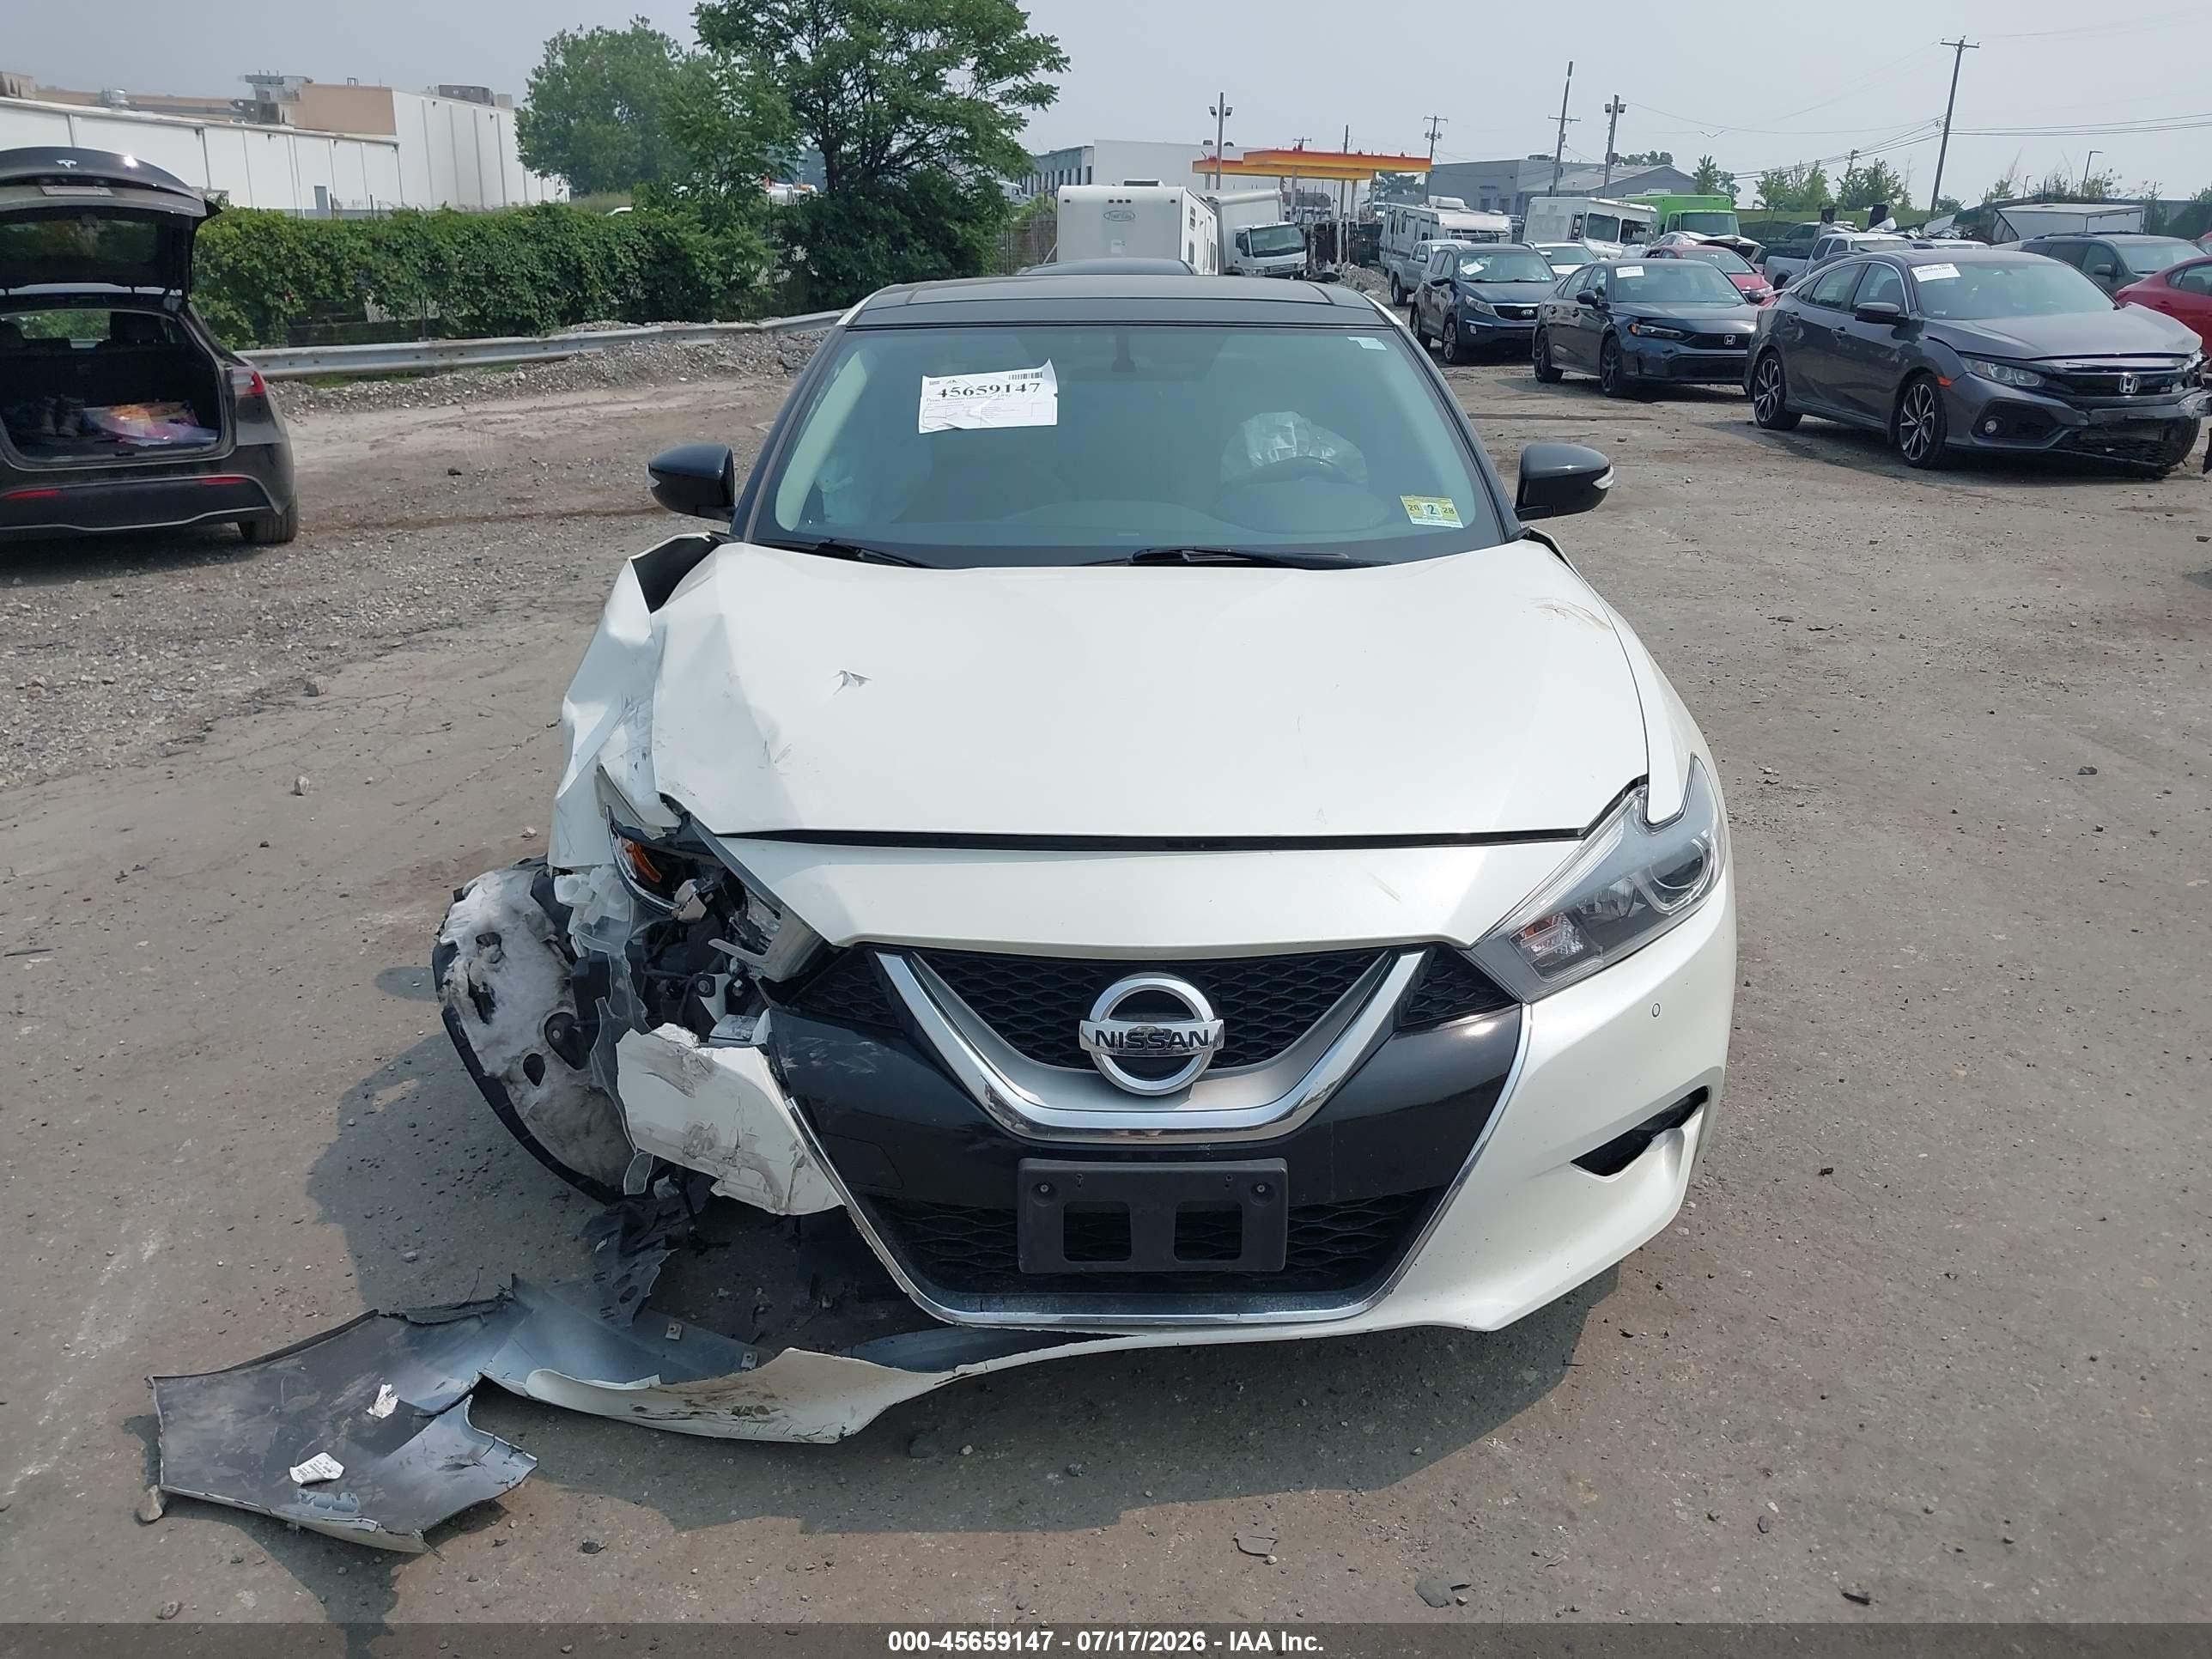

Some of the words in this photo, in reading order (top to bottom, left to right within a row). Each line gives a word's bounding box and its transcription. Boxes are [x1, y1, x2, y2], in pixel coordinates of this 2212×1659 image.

[935, 382, 1042, 398] 45659147
[1427, 504, 1437, 515] 2
[1095, 1029, 1209, 1049] NISSAN
